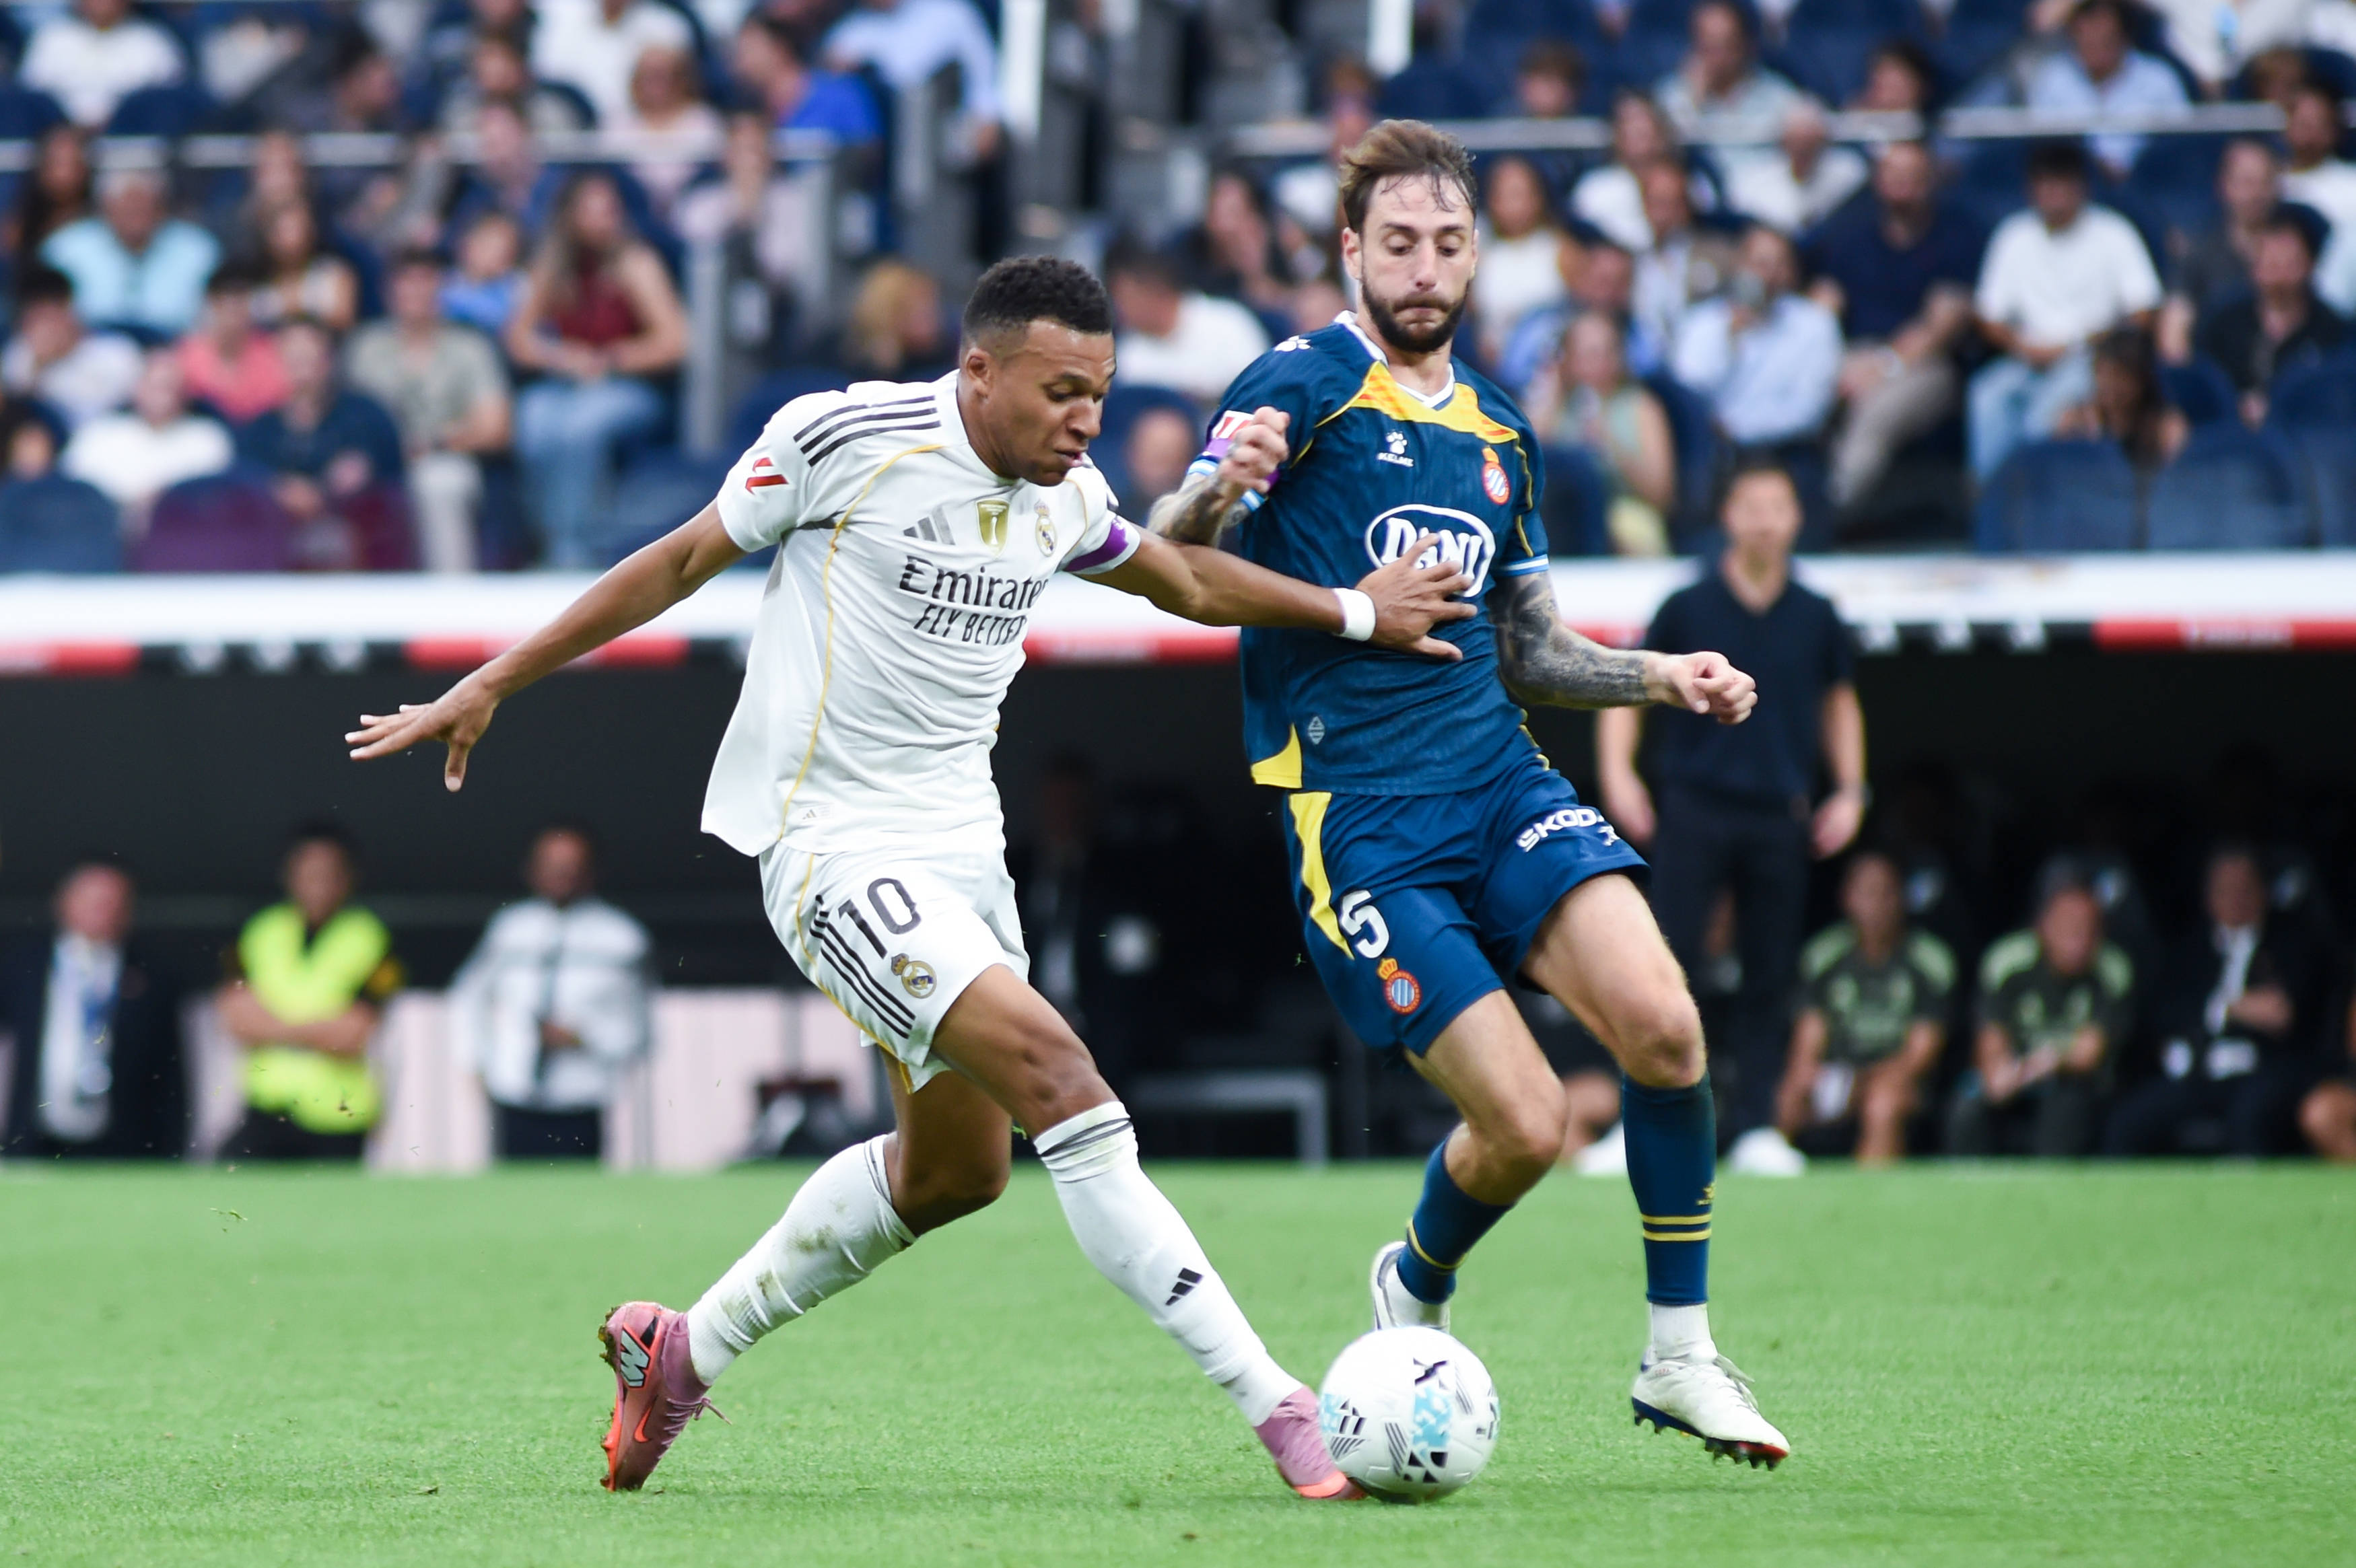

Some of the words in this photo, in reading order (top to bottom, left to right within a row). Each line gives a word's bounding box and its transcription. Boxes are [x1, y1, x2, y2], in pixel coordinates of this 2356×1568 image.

[913, 603, 963, 637] FLY
[838, 877, 922, 960] 10
[1340, 890, 1389, 958] 5
